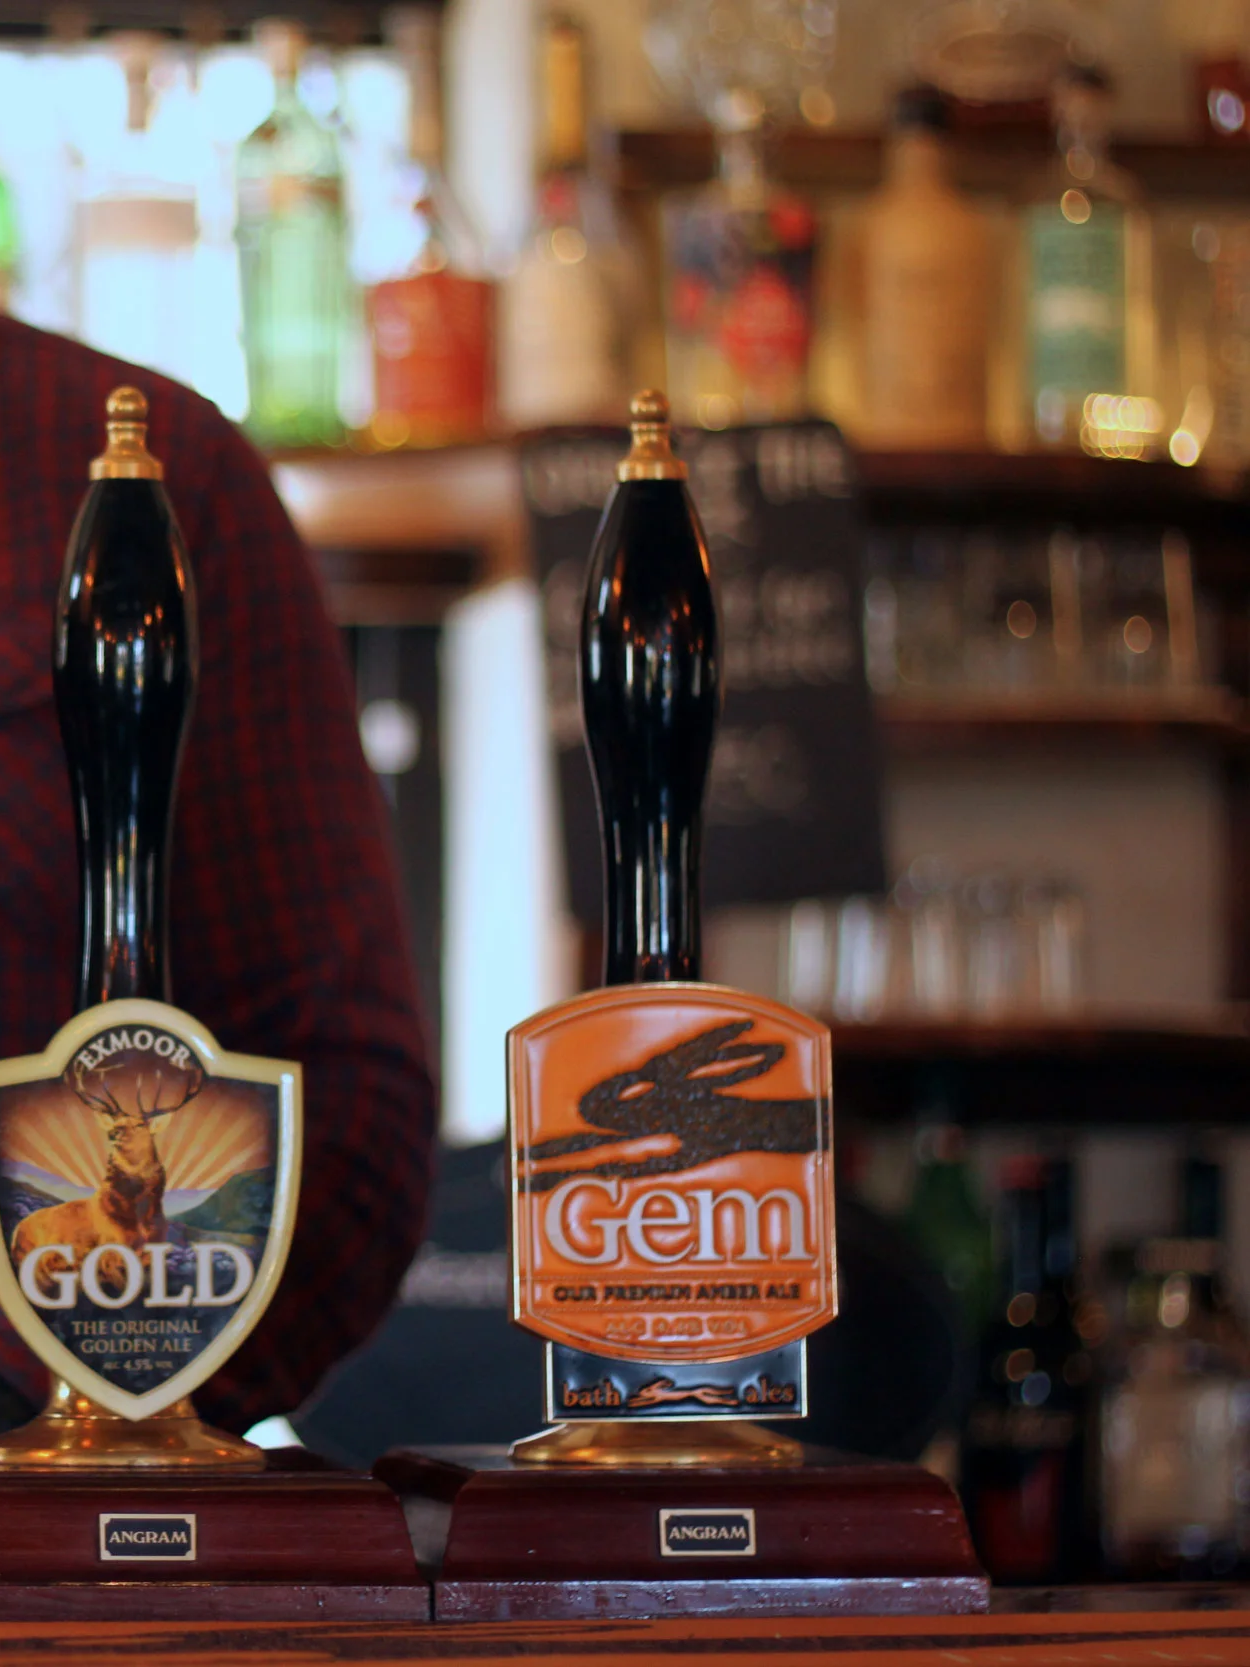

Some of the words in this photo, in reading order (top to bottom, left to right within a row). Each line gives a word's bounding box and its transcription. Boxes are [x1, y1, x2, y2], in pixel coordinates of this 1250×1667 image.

[78, 1029, 190, 1071] EXMOOR
[544, 1177, 817, 1265] Gem
[18, 1241, 255, 1309] GOLD
[553, 1285, 597, 1302] OUR
[603, 1285, 692, 1301] PREMIUM
[697, 1284, 760, 1301] AMBER
[765, 1283, 801, 1300] ALE
[71, 1321, 108, 1335] THE
[112, 1320, 202, 1334] ORIGINAL
[81, 1339, 156, 1354] GOLDEN
[161, 1338, 192, 1353] ALE
[562, 1379, 622, 1407] bath
[745, 1375, 796, 1405] ales
[108, 1530, 188, 1544] ANGRAM
[668, 1526, 747, 1540] ANGRAM
